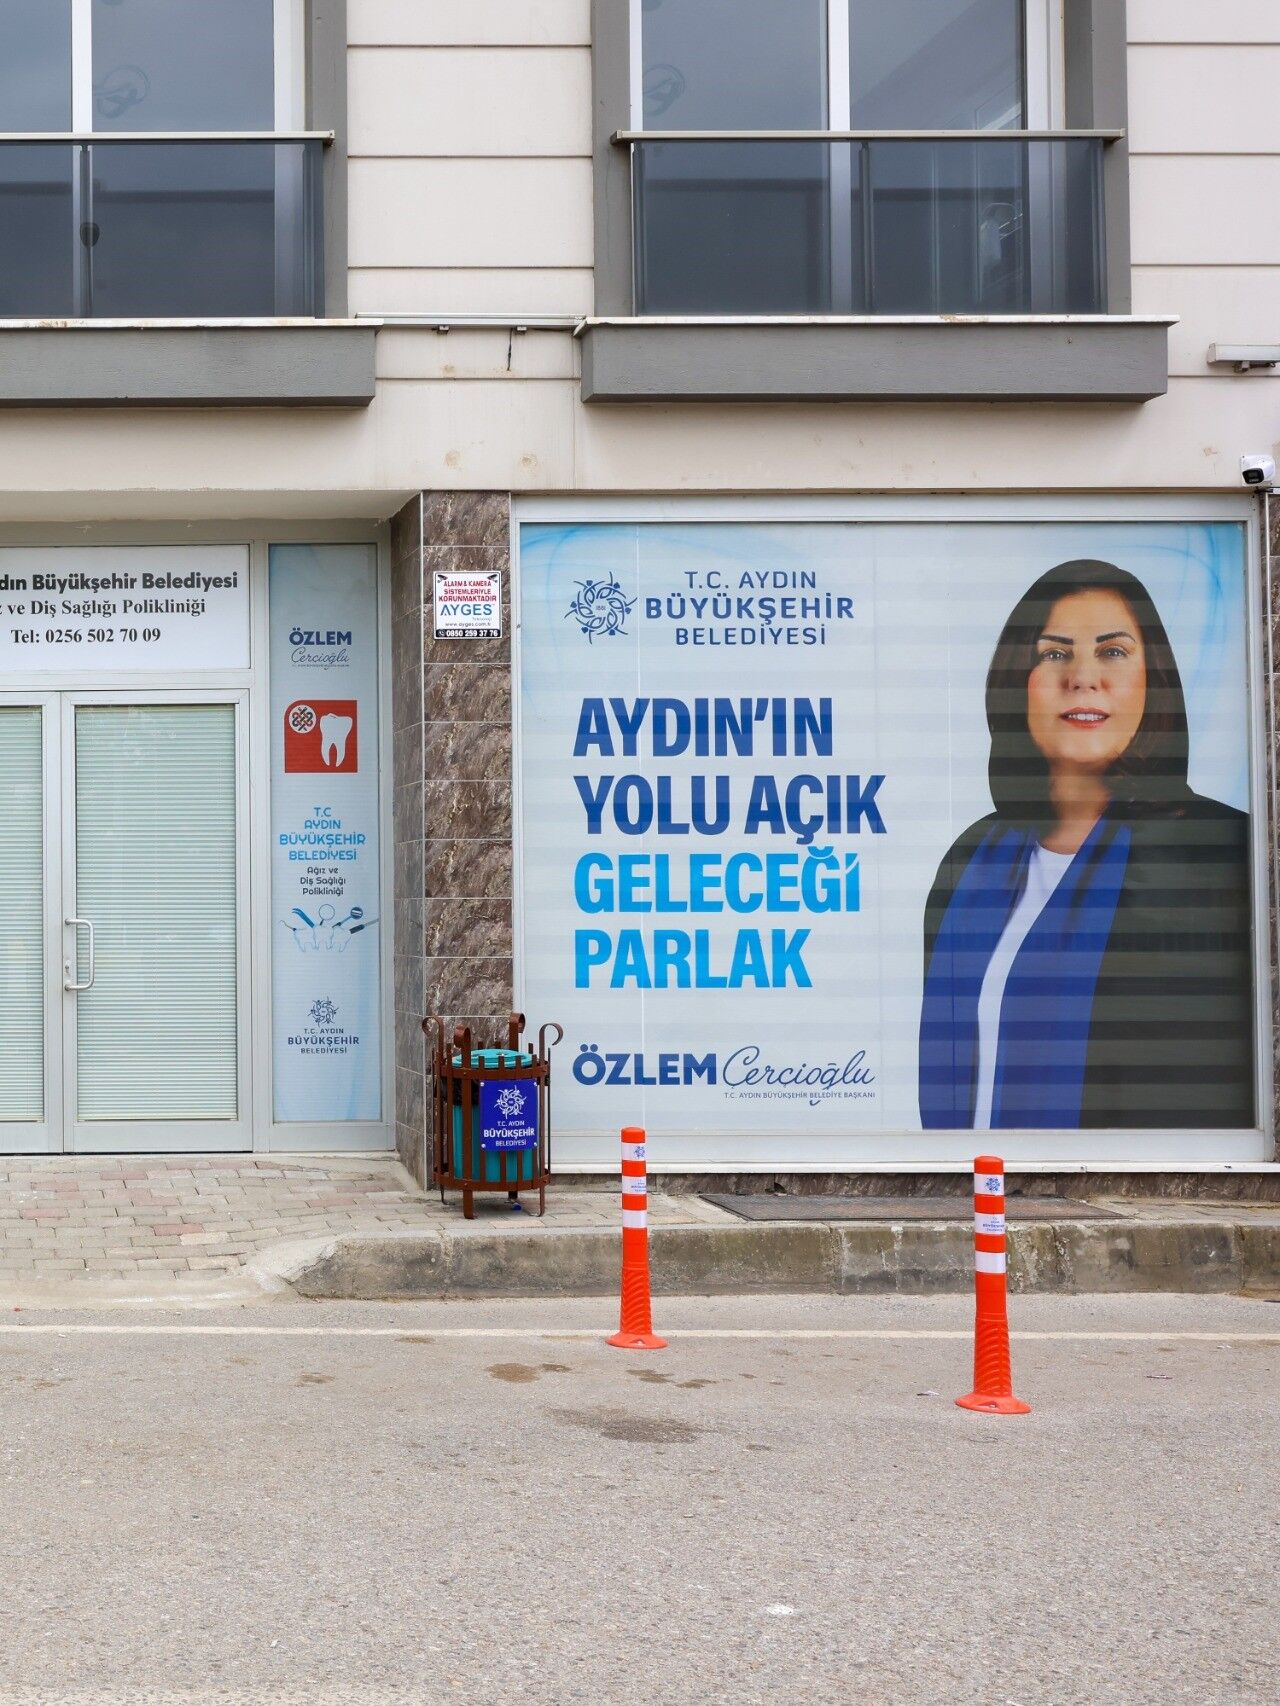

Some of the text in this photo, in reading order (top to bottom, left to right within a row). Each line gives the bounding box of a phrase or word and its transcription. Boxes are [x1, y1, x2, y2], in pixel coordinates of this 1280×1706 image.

[32, 573, 138, 595] Büyükşehir
[141, 571, 239, 593] Belediyesi
[684, 571, 816, 589] T.C. AYDIN
[6, 603, 26, 616] ve
[29, 600, 57, 617] Diş
[60, 599, 118, 618] Sağlığı
[121, 599, 206, 617] Polikliniği
[440, 603, 493, 616] AYGES
[645, 592, 855, 625] BÜYÜKŞEHİR
[10, 628, 162, 644] Tel: 0256 502 70 09
[288, 627, 352, 646] ÖZLEM
[446, 629, 464, 637] 0850
[478, 629, 488, 637] 37
[675, 624, 826, 646] BELEDİYESİ
[572, 697, 834, 758] AYDIN'IN
[573, 774, 888, 846] YOLU AÇIK
[304, 819, 342, 829] AYDIN
[279, 831, 367, 848] BÜYÜKŞEHİR
[288, 848, 357, 861] BELEDİYESİ
[307, 866, 326, 875] Ağız
[300, 876, 346, 886] Diş Sağlığı
[573, 844, 861, 915] GELECEĞİ
[302, 887, 344, 897] Polikliniği
[574, 928, 814, 990] PARLAK
[287, 1035, 360, 1047] BÜYÜKŞEHİR
[572, 1043, 717, 1086] ÖZLEM
[762, 1091, 808, 1100] BÜYÜKŞEHİR
[809, 1091, 843, 1099] BELEDİYE
[843, 1092, 876, 1100] BAŞKANI
[483, 1127, 535, 1139] BÜYÜKŞEHİR
[495, 1139, 527, 1147] BELEDİYESİ
